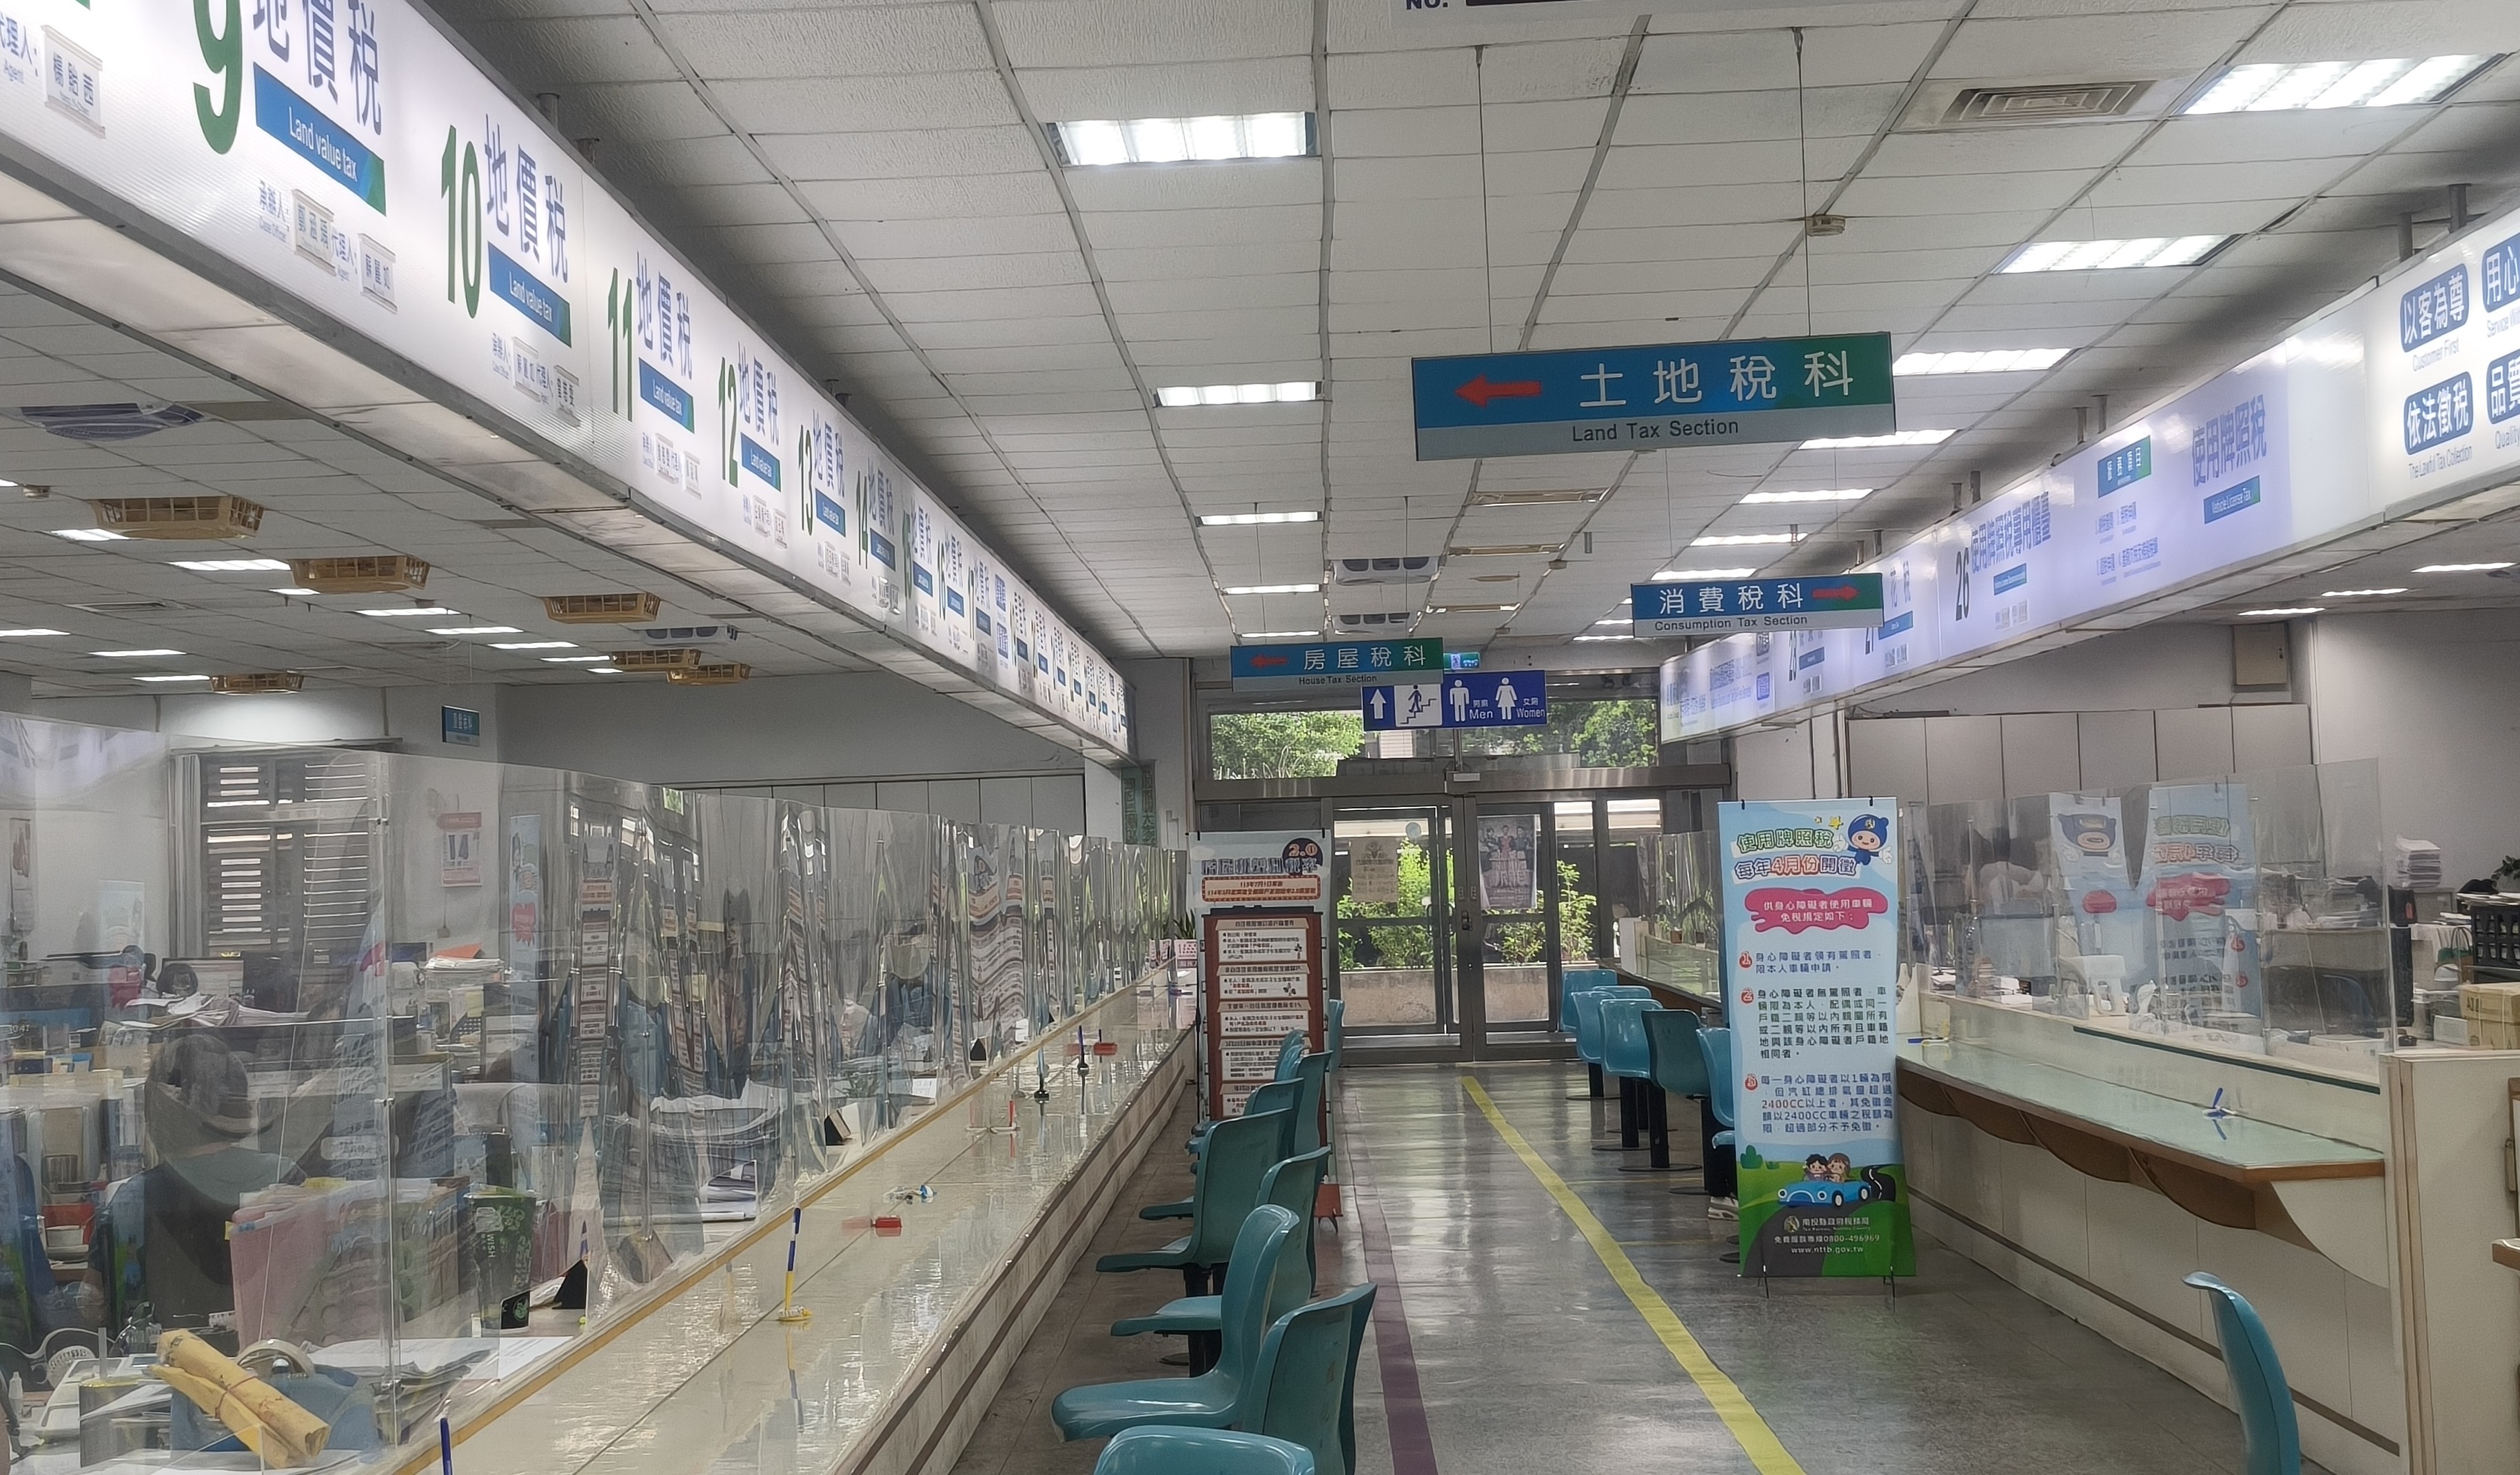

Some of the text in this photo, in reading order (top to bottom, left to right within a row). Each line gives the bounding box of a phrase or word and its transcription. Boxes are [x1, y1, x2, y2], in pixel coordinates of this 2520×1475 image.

[289, 107, 358, 183] Land value tax
[442, 125, 481, 318] 10
[2486, 245, 2520, 305] 用心
[509, 271, 553, 323] Land value tax
[2404, 272, 2465, 344] 以客為尊
[608, 267, 632, 422] 11
[2412, 337, 2460, 372] Customer First
[653, 378, 664, 405] Land
[664, 389, 675, 412] value
[1579, 349, 1854, 409] 土地稅科
[719, 357, 738, 488] 12
[1572, 417, 1740, 443] Land Tax Section
[799, 425, 813, 536] 13
[856, 470, 868, 569] 14
[1660, 582, 1804, 615] 消費稅科
[1955, 547, 1969, 621] 26
[1654, 615, 1808, 631] Consumption Tax Section
[1303, 645, 1426, 671] 房屋稅科
[1299, 674, 1377, 685] House Tax Section
[1470, 709, 1494, 719] Men
[1516, 708, 1545, 718] Women
[1289, 843, 1319, 857] 2.0
[1736, 828, 1834, 854] 使用牌照稅
[1734, 855, 1857, 879] 每年4月份開徵
[1791, 1245, 1864, 1254] www.nttb.gov.tw
